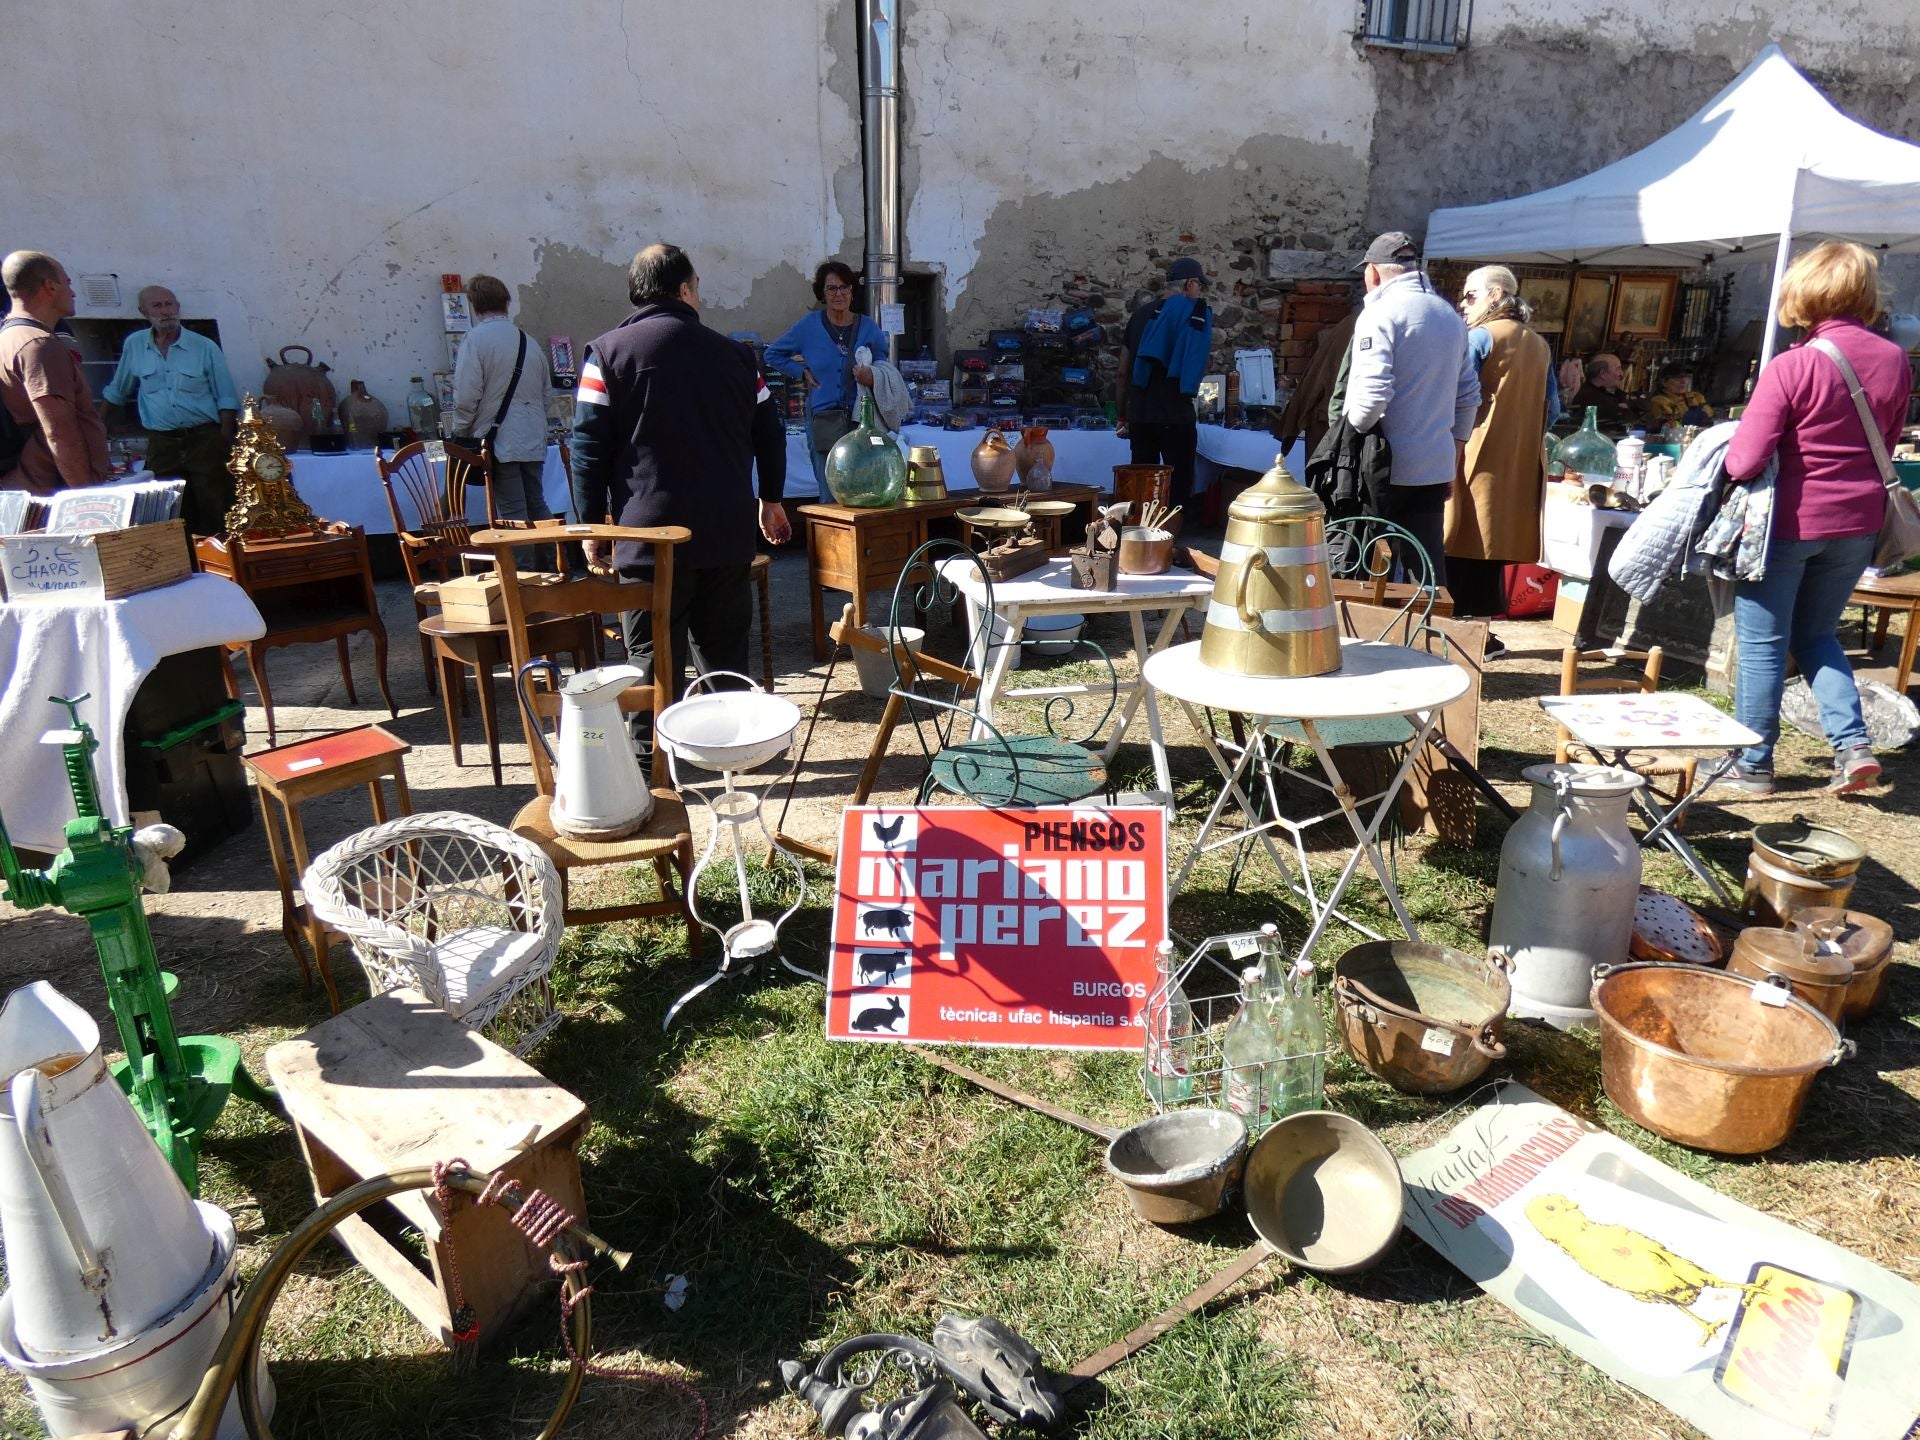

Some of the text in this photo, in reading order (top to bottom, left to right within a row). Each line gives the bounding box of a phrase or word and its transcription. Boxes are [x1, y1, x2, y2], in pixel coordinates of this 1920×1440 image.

[12, 562, 80, 580] CHAPAS
[1024, 821, 1146, 851] PIENSOS
[857, 843, 1146, 901] mariano
[939, 904, 1146, 960] perez
[1072, 981, 1147, 999] BURGOS
[939, 1005, 1003, 1023] tècnica:
[1008, 1007, 1042, 1025] ufac
[1048, 1009, 1115, 1028] hispania
[1431, 1116, 1586, 1231] LOS BARRANCALES
